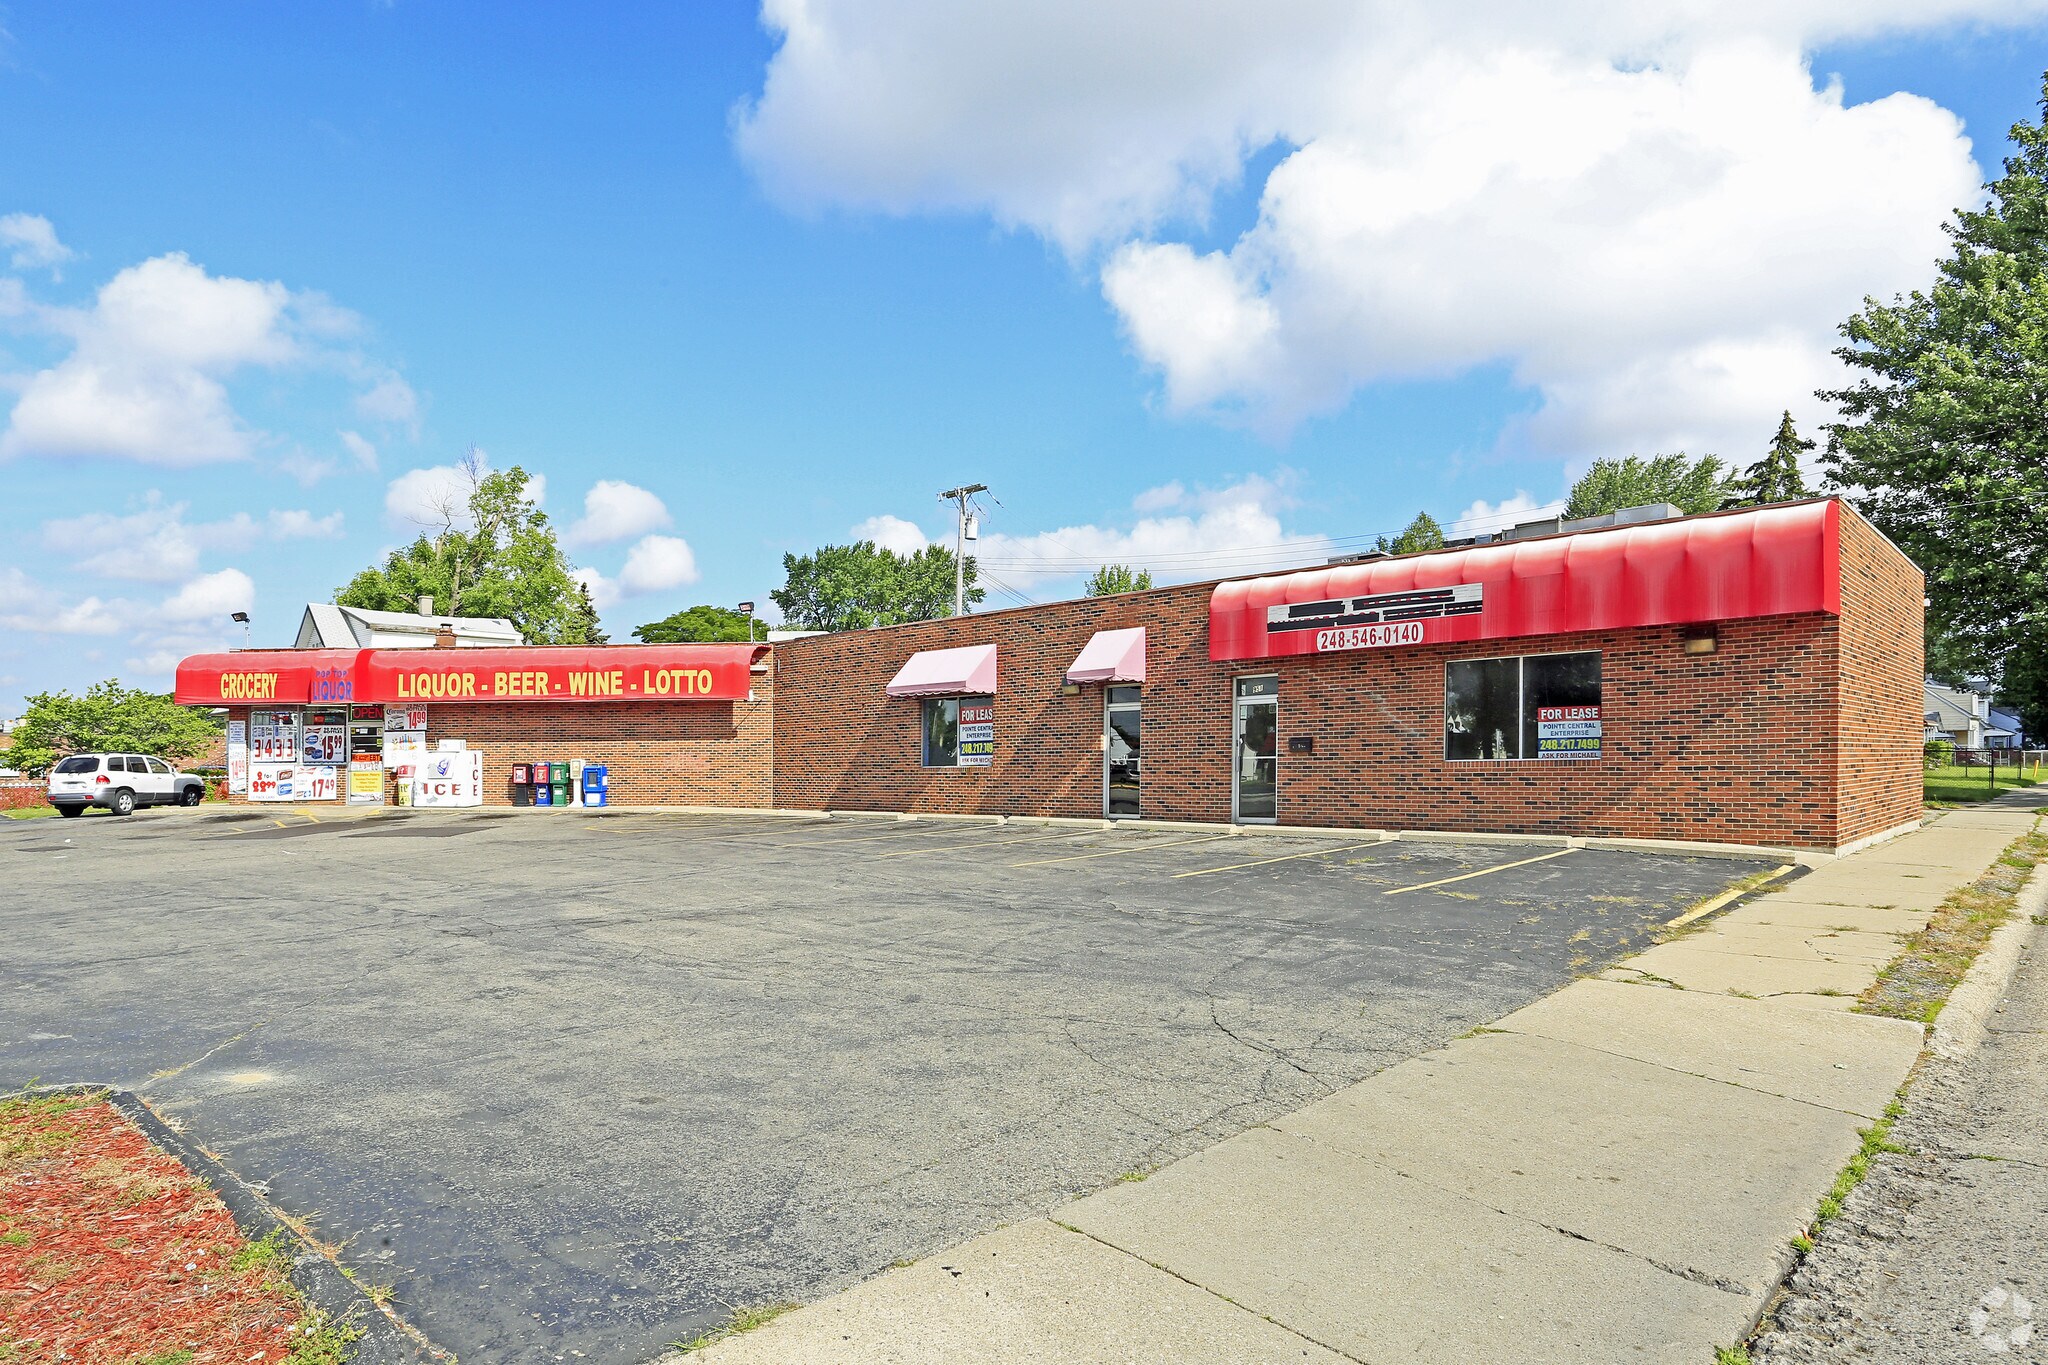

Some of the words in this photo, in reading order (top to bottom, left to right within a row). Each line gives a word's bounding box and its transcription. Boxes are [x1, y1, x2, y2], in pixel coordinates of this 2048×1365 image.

[1321, 624, 1419, 649] 248-546-0140
[315, 670, 330, 678] POP
[333, 670, 347, 678] TOP
[220, 672, 278, 699] GROCERY
[398, 673, 476, 698] LIQUOR
[494, 672, 549, 696] BEER
[568, 671, 623, 696] WINE
[643, 669, 713, 695] LOTTO
[312, 681, 352, 701] LIQUOR
[352, 707, 383, 719] OPEN
[962, 710, 974, 721] FOR
[1541, 709, 1562, 719] FOR
[1565, 708, 1598, 718] LEASE
[1540, 739, 1600, 750] 248.217.7499
[423, 783, 461, 796] ICE
